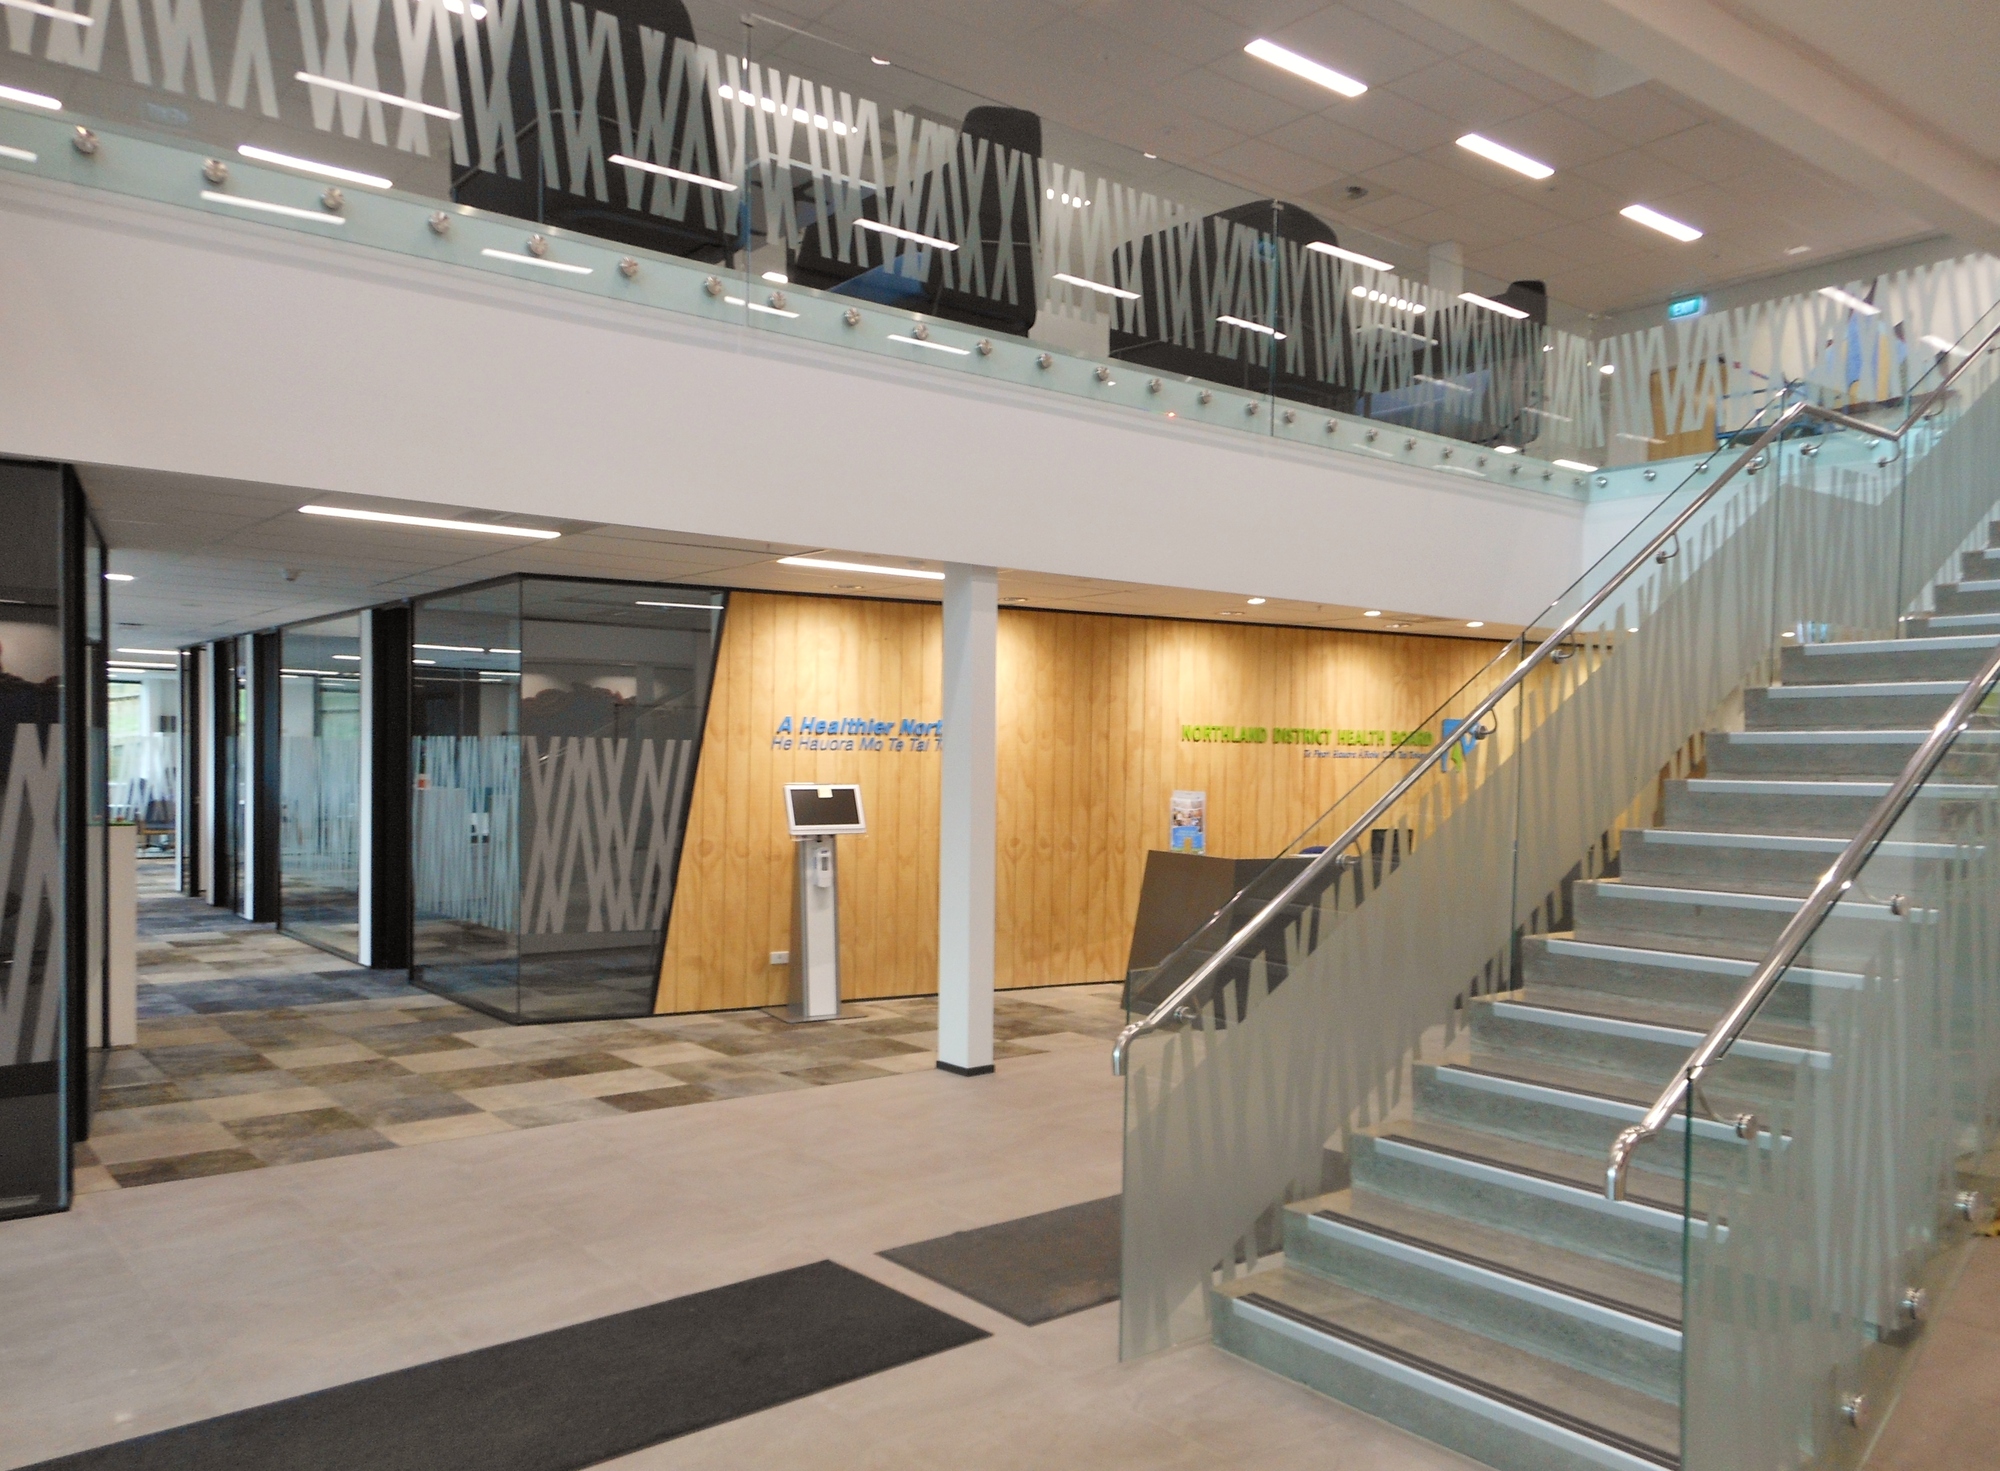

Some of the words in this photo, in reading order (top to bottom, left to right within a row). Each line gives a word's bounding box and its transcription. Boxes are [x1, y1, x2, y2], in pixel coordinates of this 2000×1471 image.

[776, 716, 793, 735] A
[799, 717, 895, 736] Healthier
[899, 718, 944, 738] Nort
[1181, 725, 1267, 744] NORTHLAND
[1273, 727, 1332, 746] DISTRICT
[1337, 730, 1385, 747] HEALTH
[772, 736, 793, 750] He
[798, 736, 854, 751] Hauora
[889, 738, 904, 751] Te
[910, 737, 930, 752] Tai
